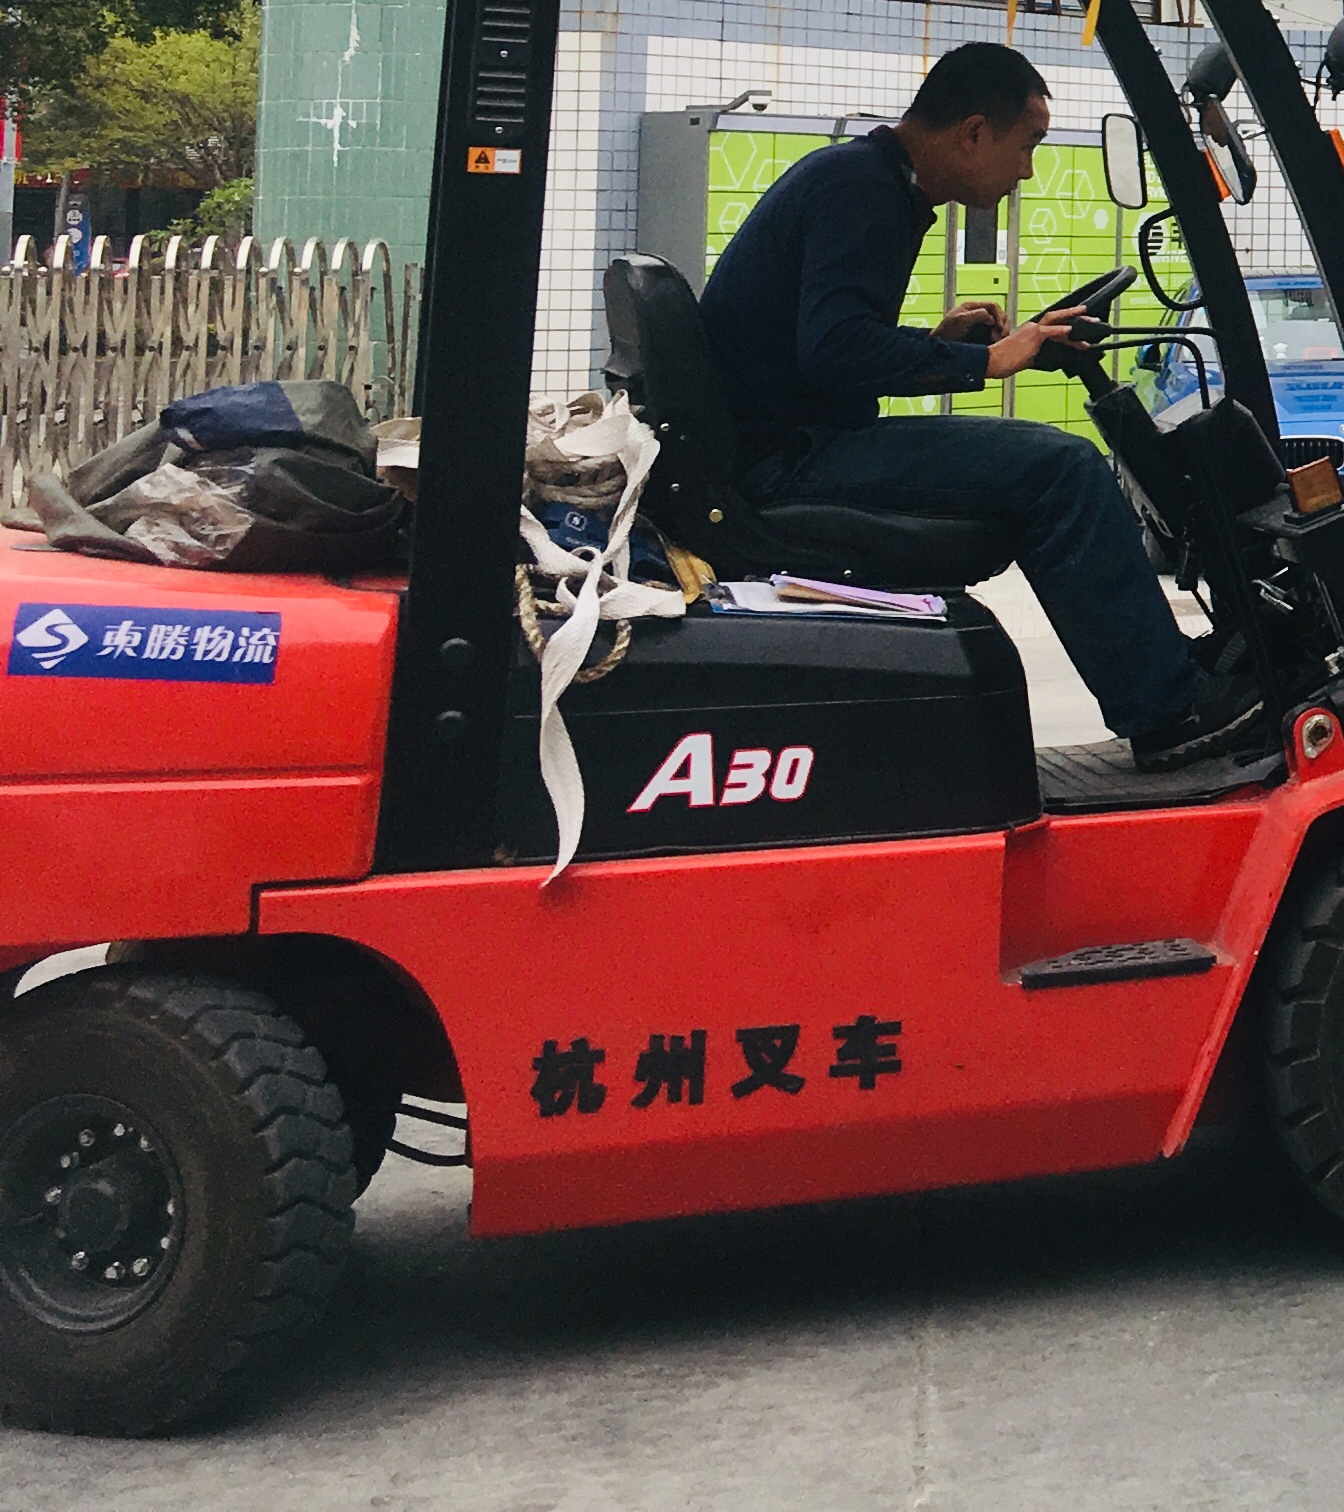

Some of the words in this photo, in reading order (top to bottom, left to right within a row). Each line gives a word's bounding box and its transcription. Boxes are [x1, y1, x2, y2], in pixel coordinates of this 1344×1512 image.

[96, 619, 281, 665] 東勝物流
[626, 731, 815, 814] A30
[530, 1014, 904, 1118] 杭州叉车
